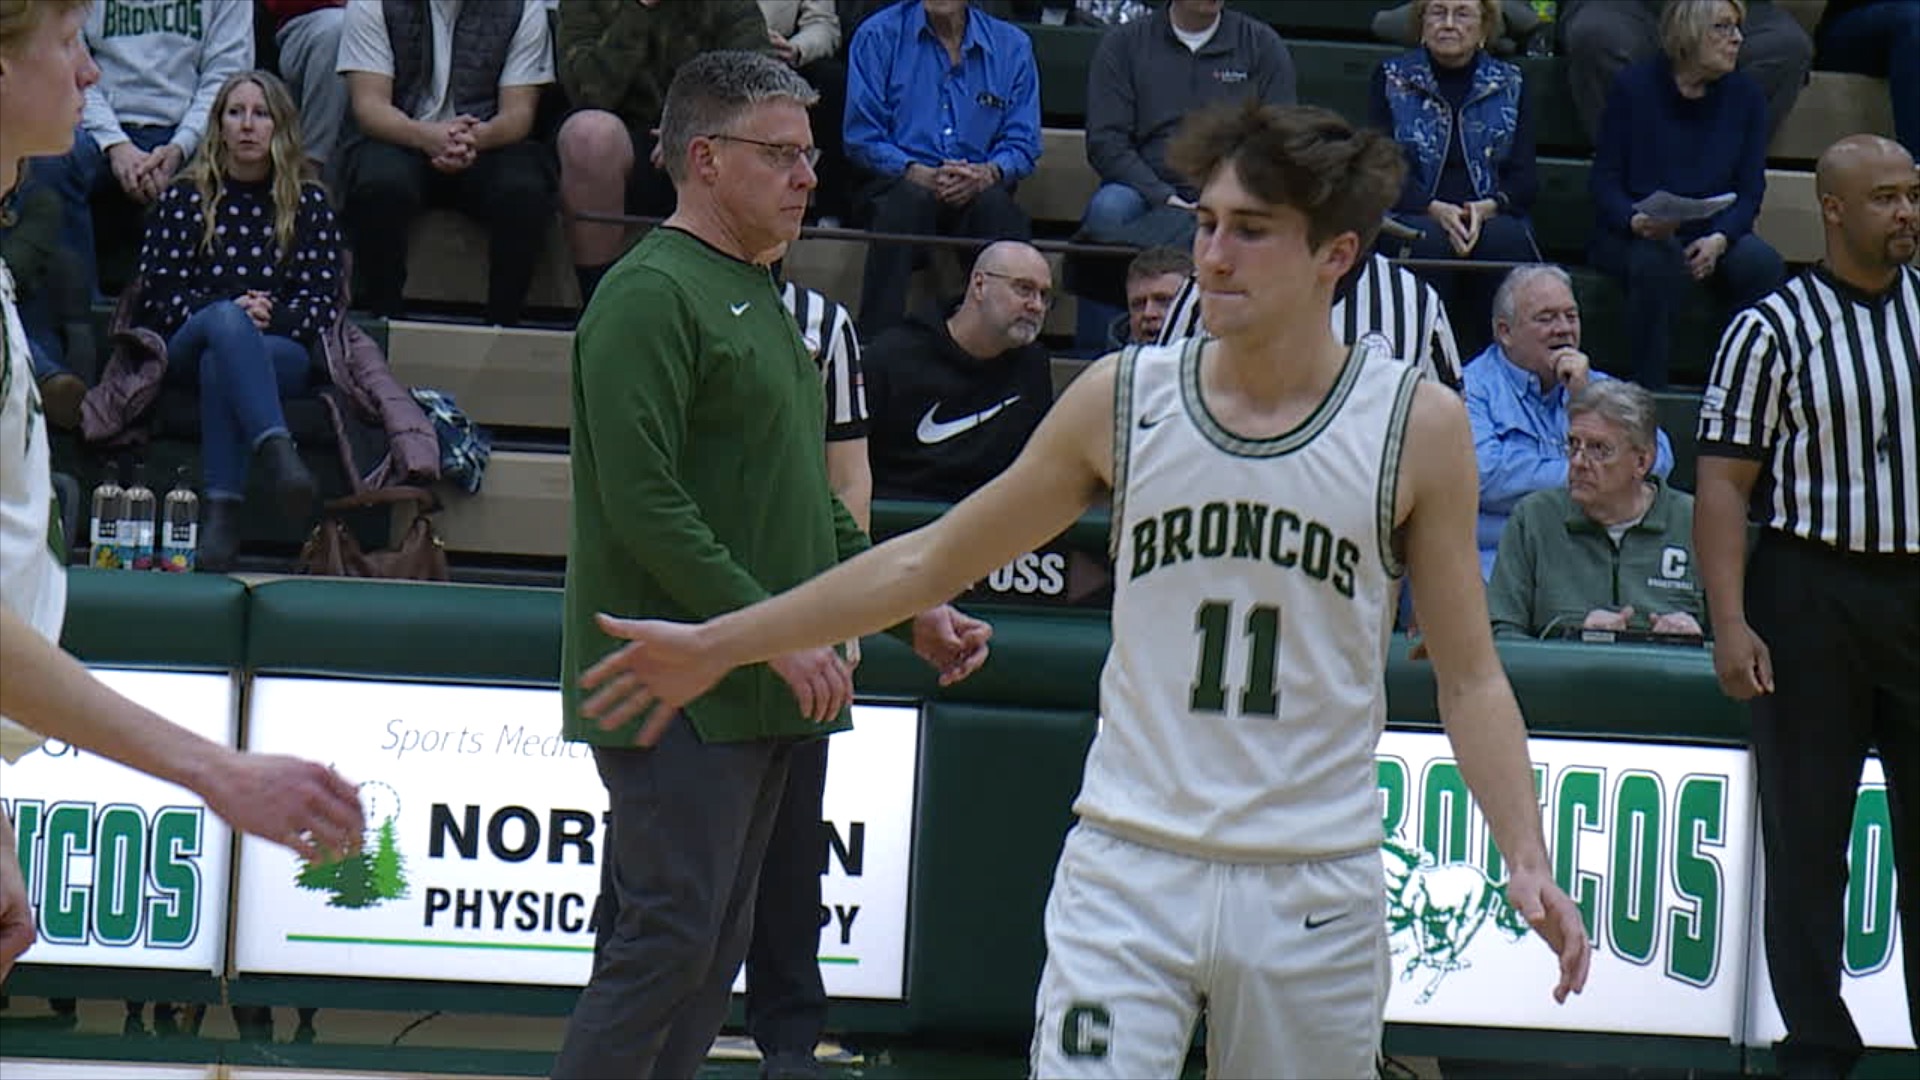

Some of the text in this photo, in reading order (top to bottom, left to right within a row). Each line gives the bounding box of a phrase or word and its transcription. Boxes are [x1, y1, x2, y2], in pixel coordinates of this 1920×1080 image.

[102, 0, 202, 40] BRONCOS
[1130, 501, 1361, 599] BRONCOS
[1660, 544, 1687, 579] C
[985, 551, 1066, 596] OSS
[1188, 599, 1281, 719] 11
[381, 718, 482, 760] Sports
[1059, 1000, 1112, 1060] C
